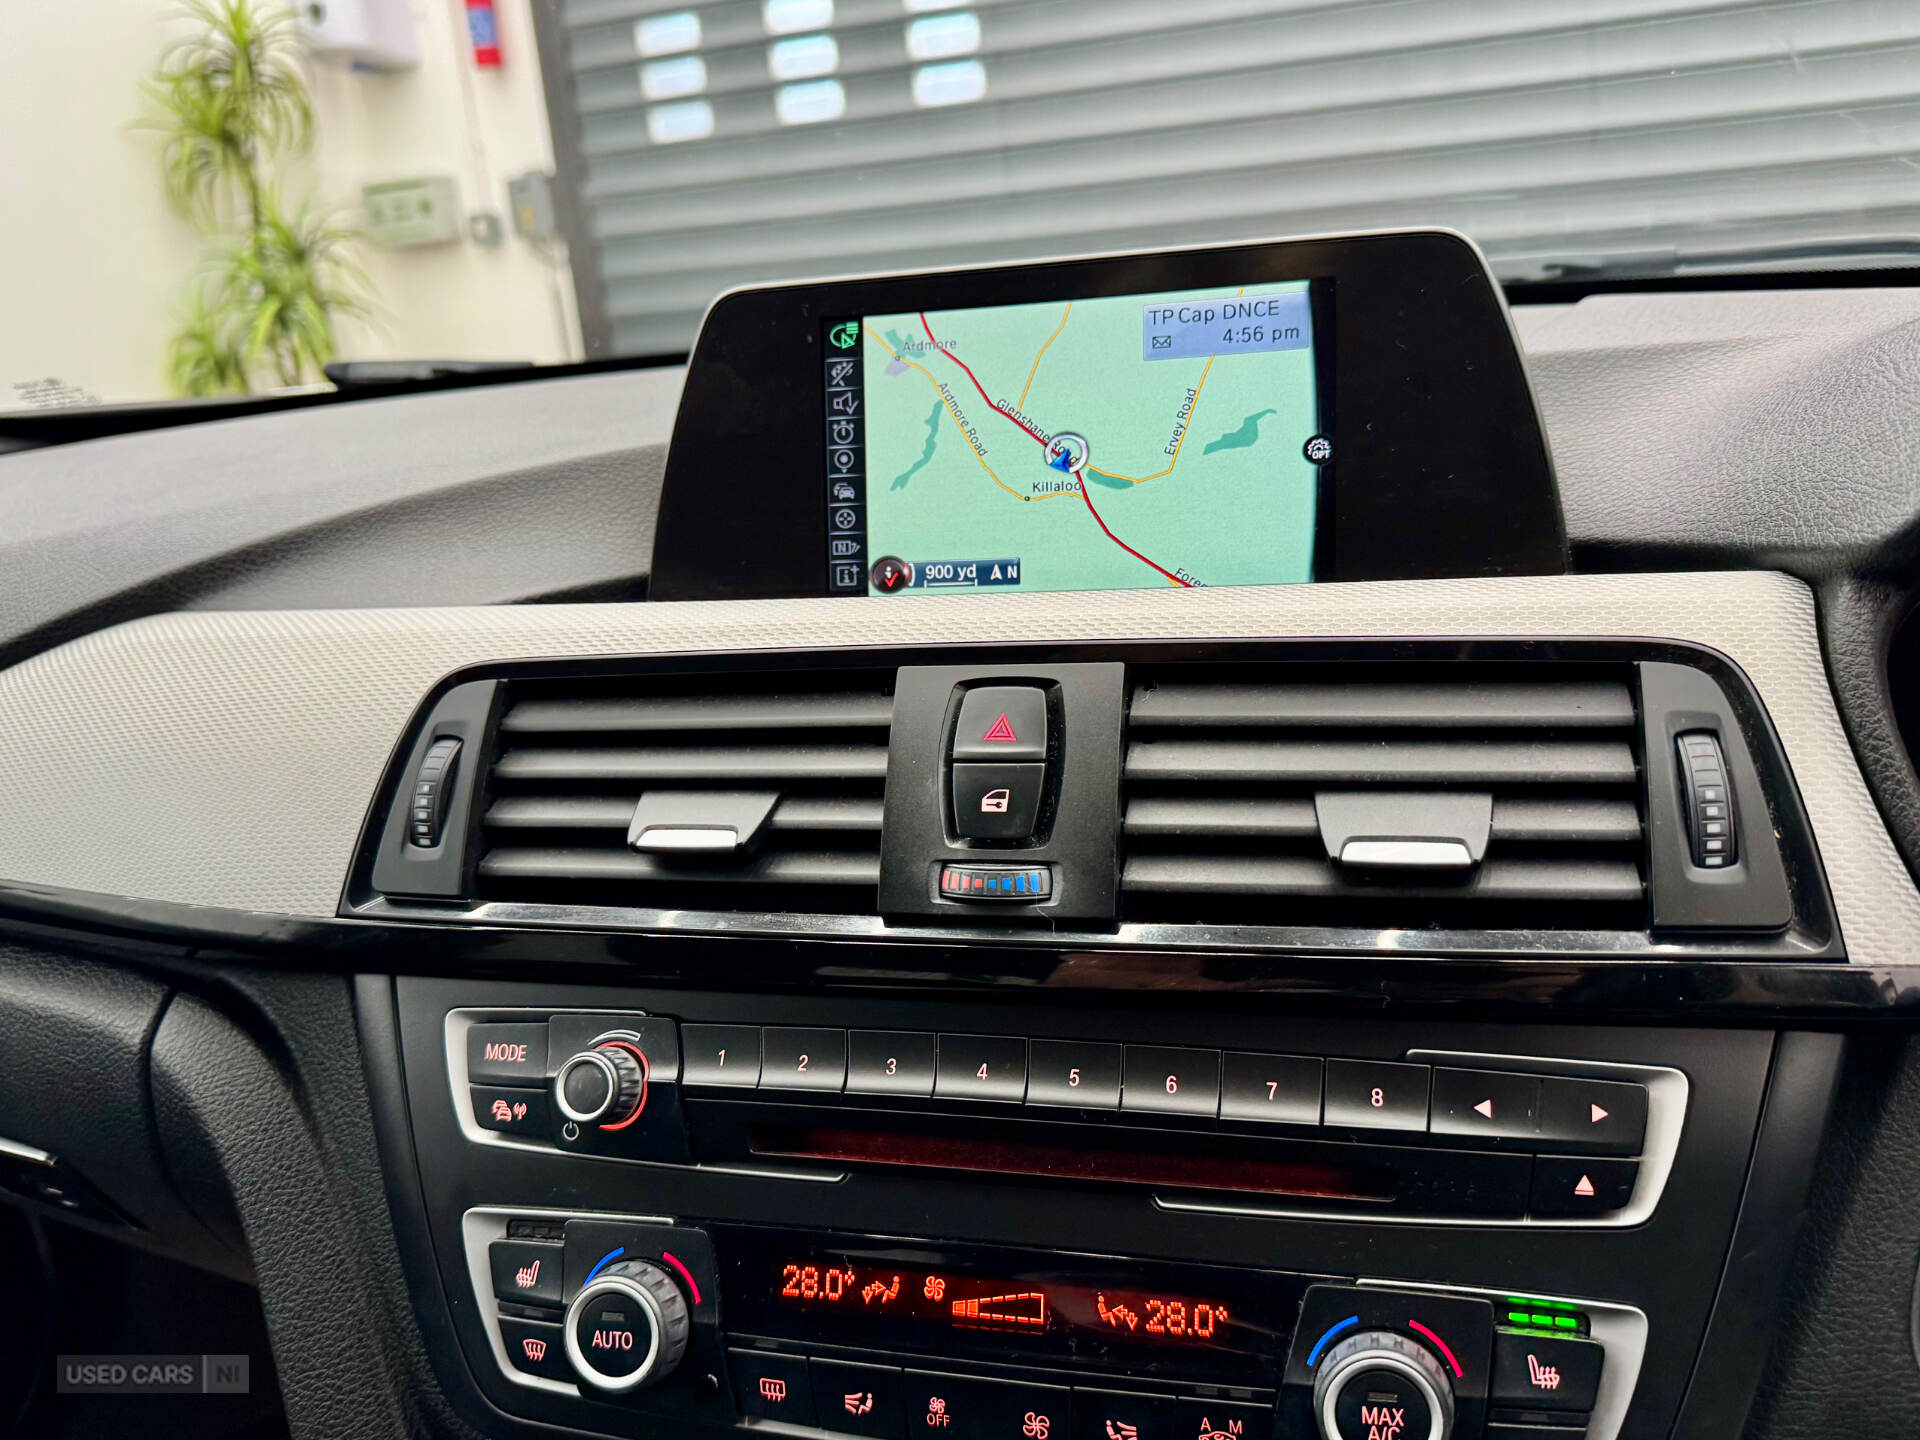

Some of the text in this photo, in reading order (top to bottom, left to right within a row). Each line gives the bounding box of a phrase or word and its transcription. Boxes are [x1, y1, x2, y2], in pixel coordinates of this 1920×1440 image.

[1149, 300, 1280, 325] TP Cap DNCE
[1222, 326, 1300, 344] 4:56 pm
[903, 338, 957, 352] Ardmore
[938, 382, 988, 457] Ardmore Road
[996, 399, 1050, 442] Glenshane
[1164, 388, 1197, 456] Ervey Road
[1311, 450, 1330, 460] OPT
[1032, 480, 1081, 493] Killaloo
[925, 563, 976, 581] 900 yd
[1007, 566, 1017, 578] N
[1174, 567, 1208, 587] Fore
[485, 1043, 527, 1062] MODE
[717, 1050, 726, 1067] 1
[797, 1054, 809, 1072] 2
[885, 1058, 897, 1076] 3
[976, 1063, 989, 1081] 4
[1068, 1068, 1081, 1087] 5
[1165, 1075, 1178, 1095] 6
[1265, 1081, 1279, 1101] 7
[1370, 1088, 1384, 1108] 8
[591, 1330, 634, 1352] AUTO
[926, 1413, 950, 1428] OFF
[1200, 1417, 1211, 1432] A
[1361, 1405, 1405, 1427] MAX
[1228, 1420, 1242, 1434] M
